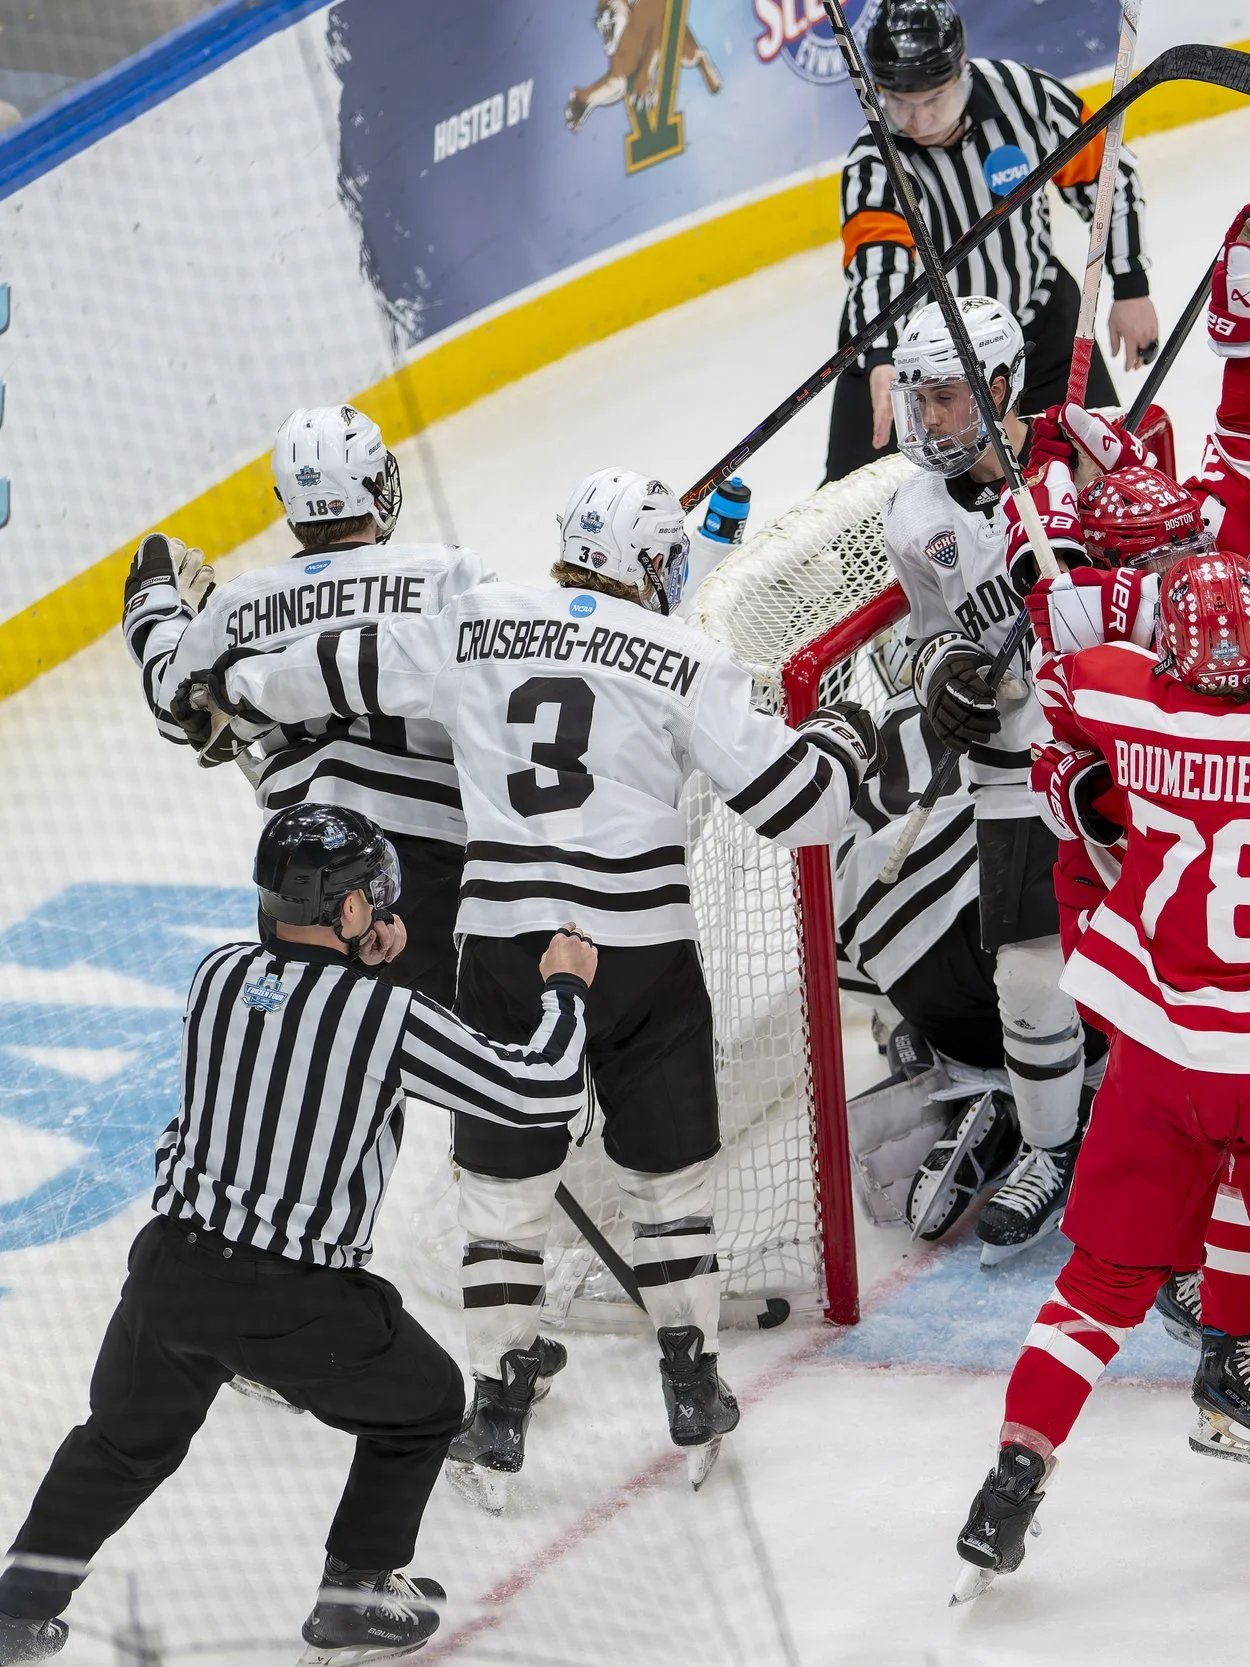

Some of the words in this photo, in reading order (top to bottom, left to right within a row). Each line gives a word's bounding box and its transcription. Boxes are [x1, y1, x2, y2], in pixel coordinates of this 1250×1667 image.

[434, 92, 504, 163] HOSTED
[507, 78, 534, 127] BY
[991, 164, 1030, 187] NCAA
[908, 331, 920, 342] 14
[978, 335, 1004, 348] BAUER
[975, 492, 999, 506] adidas
[1153, 490, 1177, 507] 34
[306, 500, 328, 516] 18
[1164, 511, 1194, 531] BOSTON
[579, 545, 590, 563] 3
[571, 604, 594, 613] NCAA
[1109, 567, 1136, 634] UER
[225, 575, 426, 650] SCHINGOETHE
[456, 619, 701, 698] CRUSBERG-ROSEEN
[1215, 674, 1239, 688] 78
[506, 676, 596, 818] 3
[246, 986, 270, 998] FROZEN
[269, 993, 285, 1001] FOUR
[894, 1034, 918, 1064] BAUER
[367, 1626, 403, 1642] BAUER
